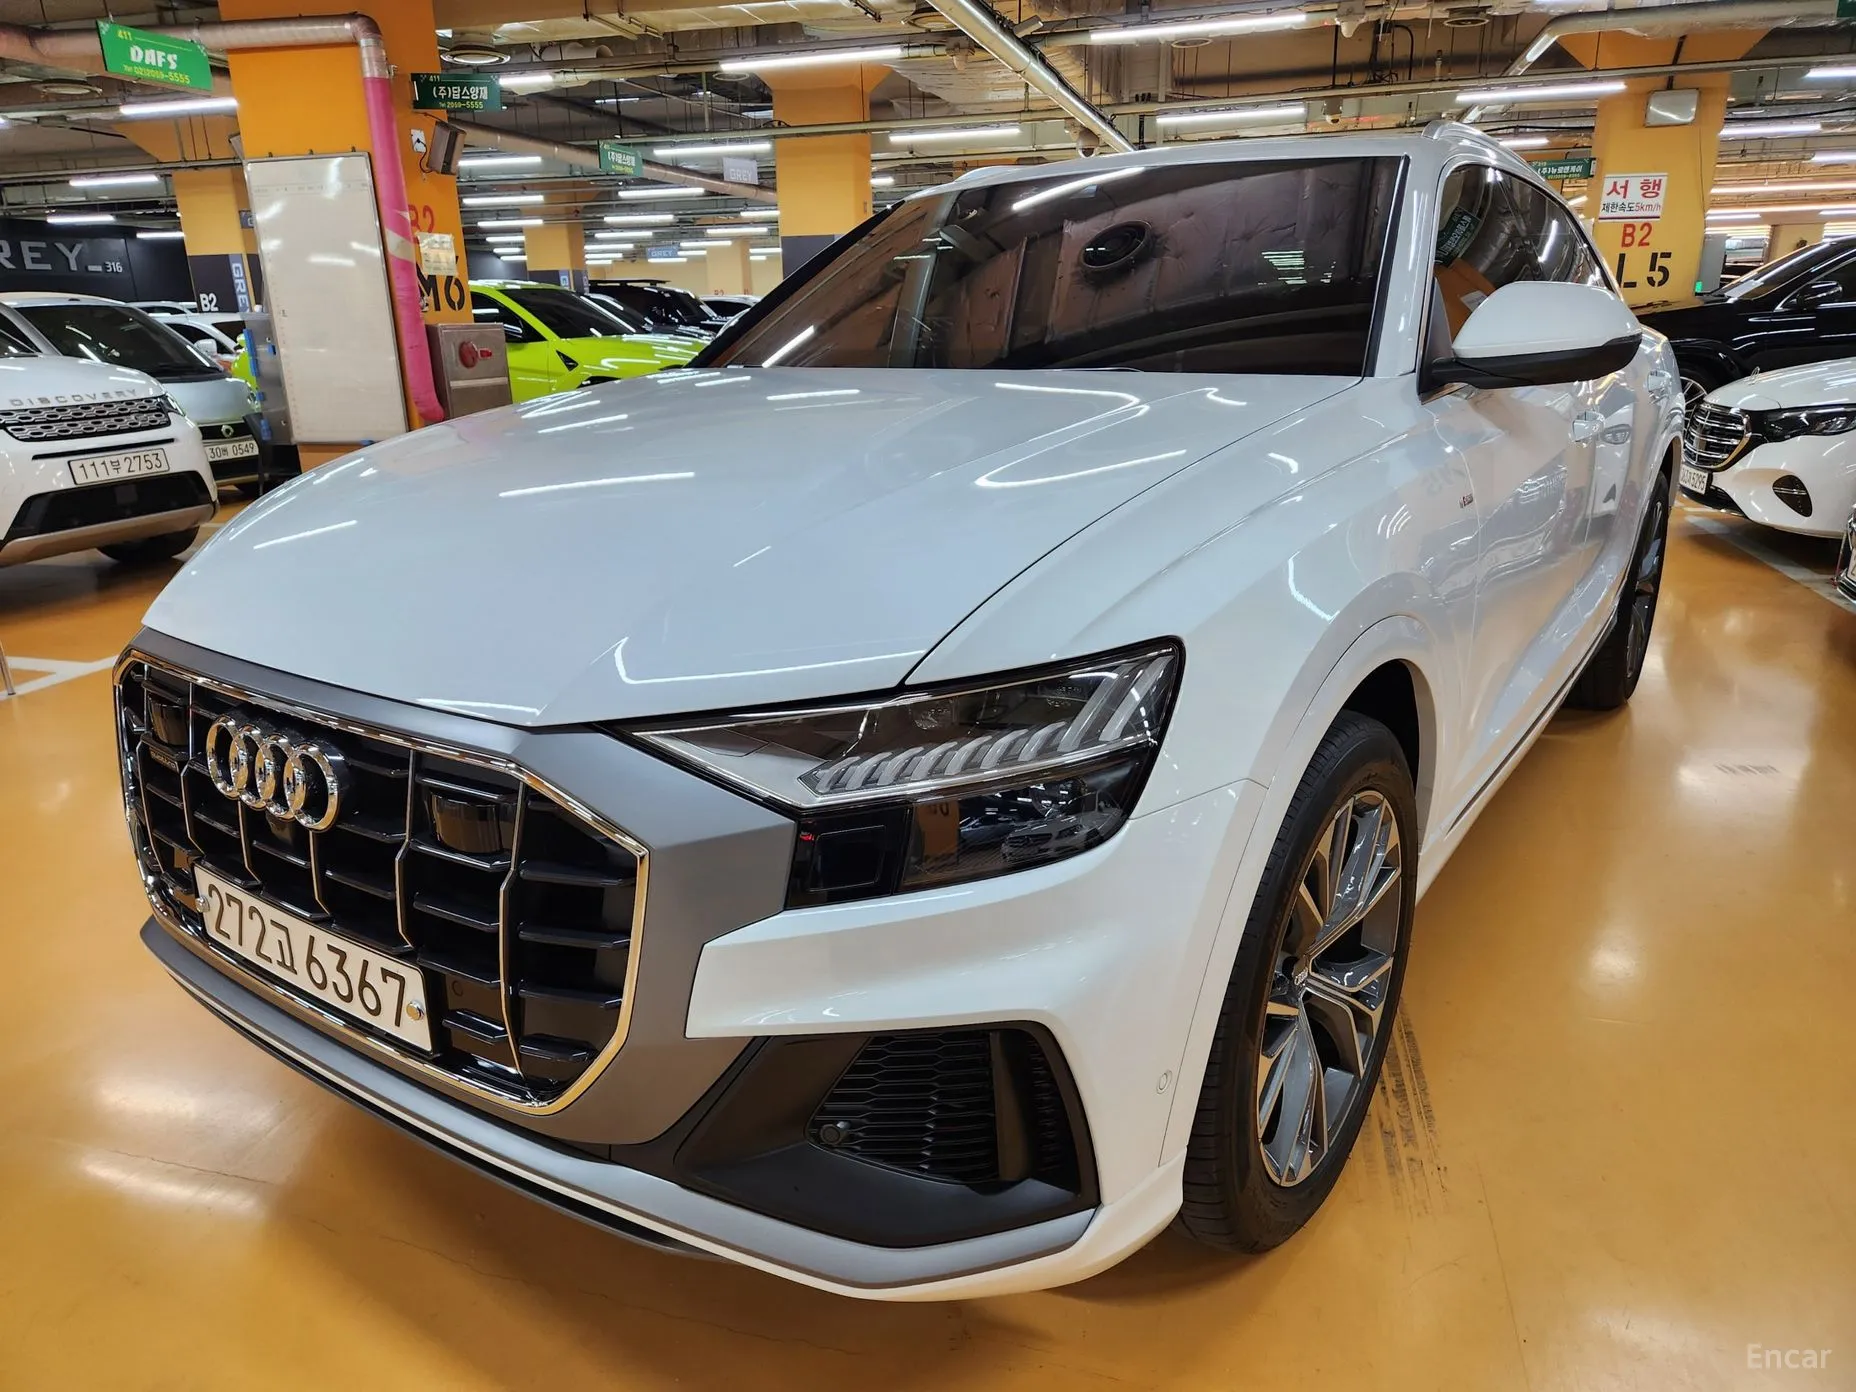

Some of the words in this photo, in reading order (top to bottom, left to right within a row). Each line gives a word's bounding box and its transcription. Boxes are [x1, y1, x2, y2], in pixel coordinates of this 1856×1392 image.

[117, 29, 132, 41] 411
[1621, 222, 1653, 248] B2
[105, 261, 123, 273] 316
[231, 263, 250, 312] GRE
[199, 292, 219, 312] B2
[8, 388, 138, 408] DISCOVERY
